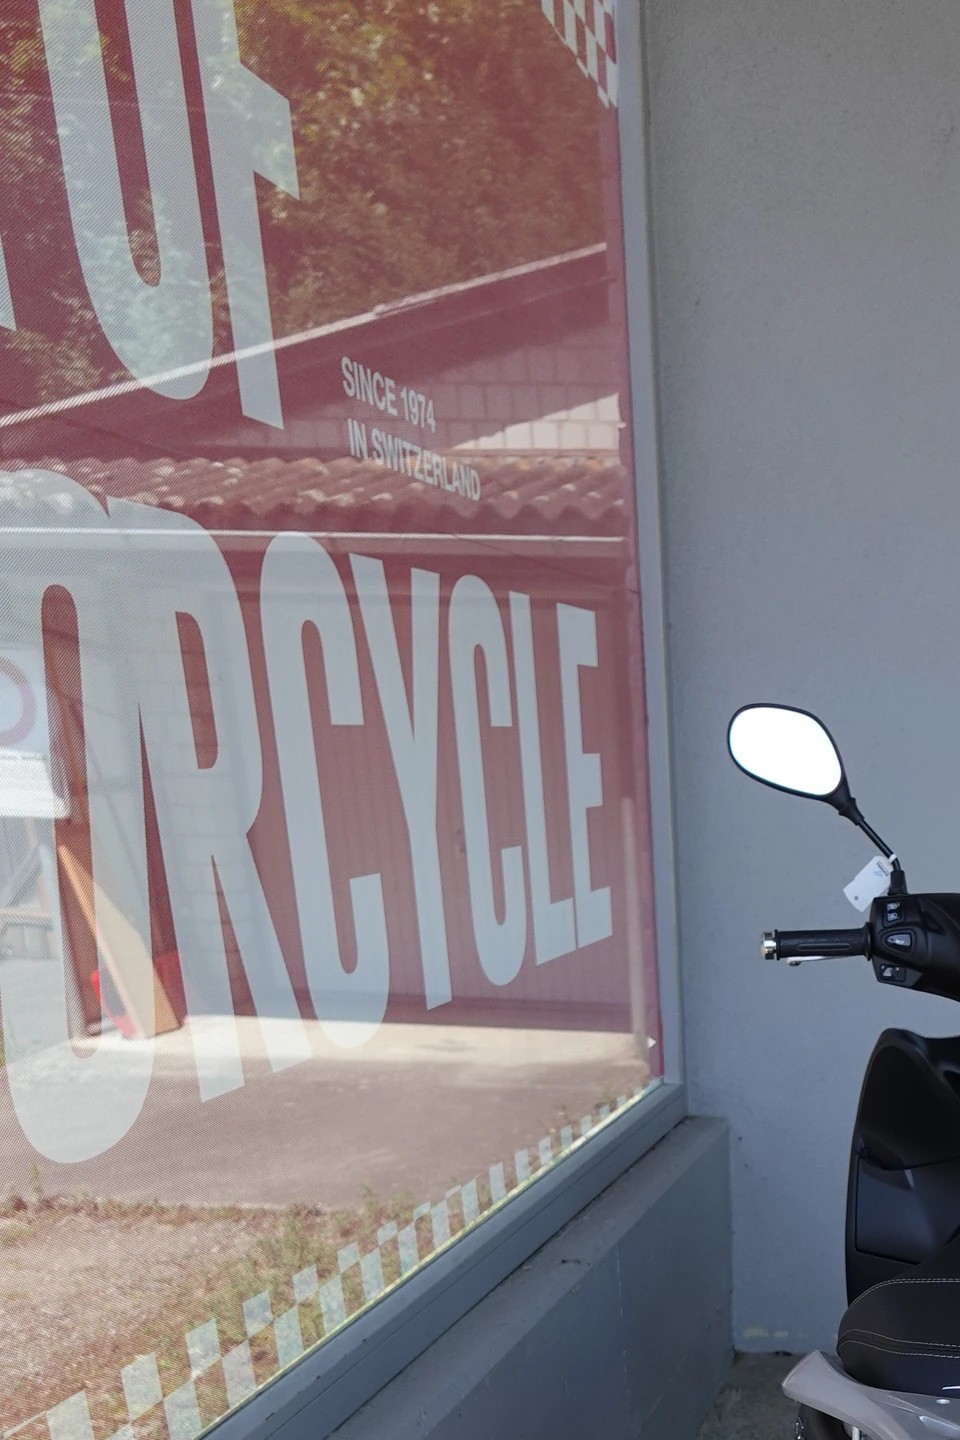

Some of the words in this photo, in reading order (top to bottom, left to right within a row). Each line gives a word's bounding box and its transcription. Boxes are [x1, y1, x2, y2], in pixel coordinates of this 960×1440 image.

[341, 356, 399, 416] SINCE
[401, 387, 437, 433] 1974
[347, 418, 369, 463] IN
[370, 427, 481, 501] SWITZERLAND
